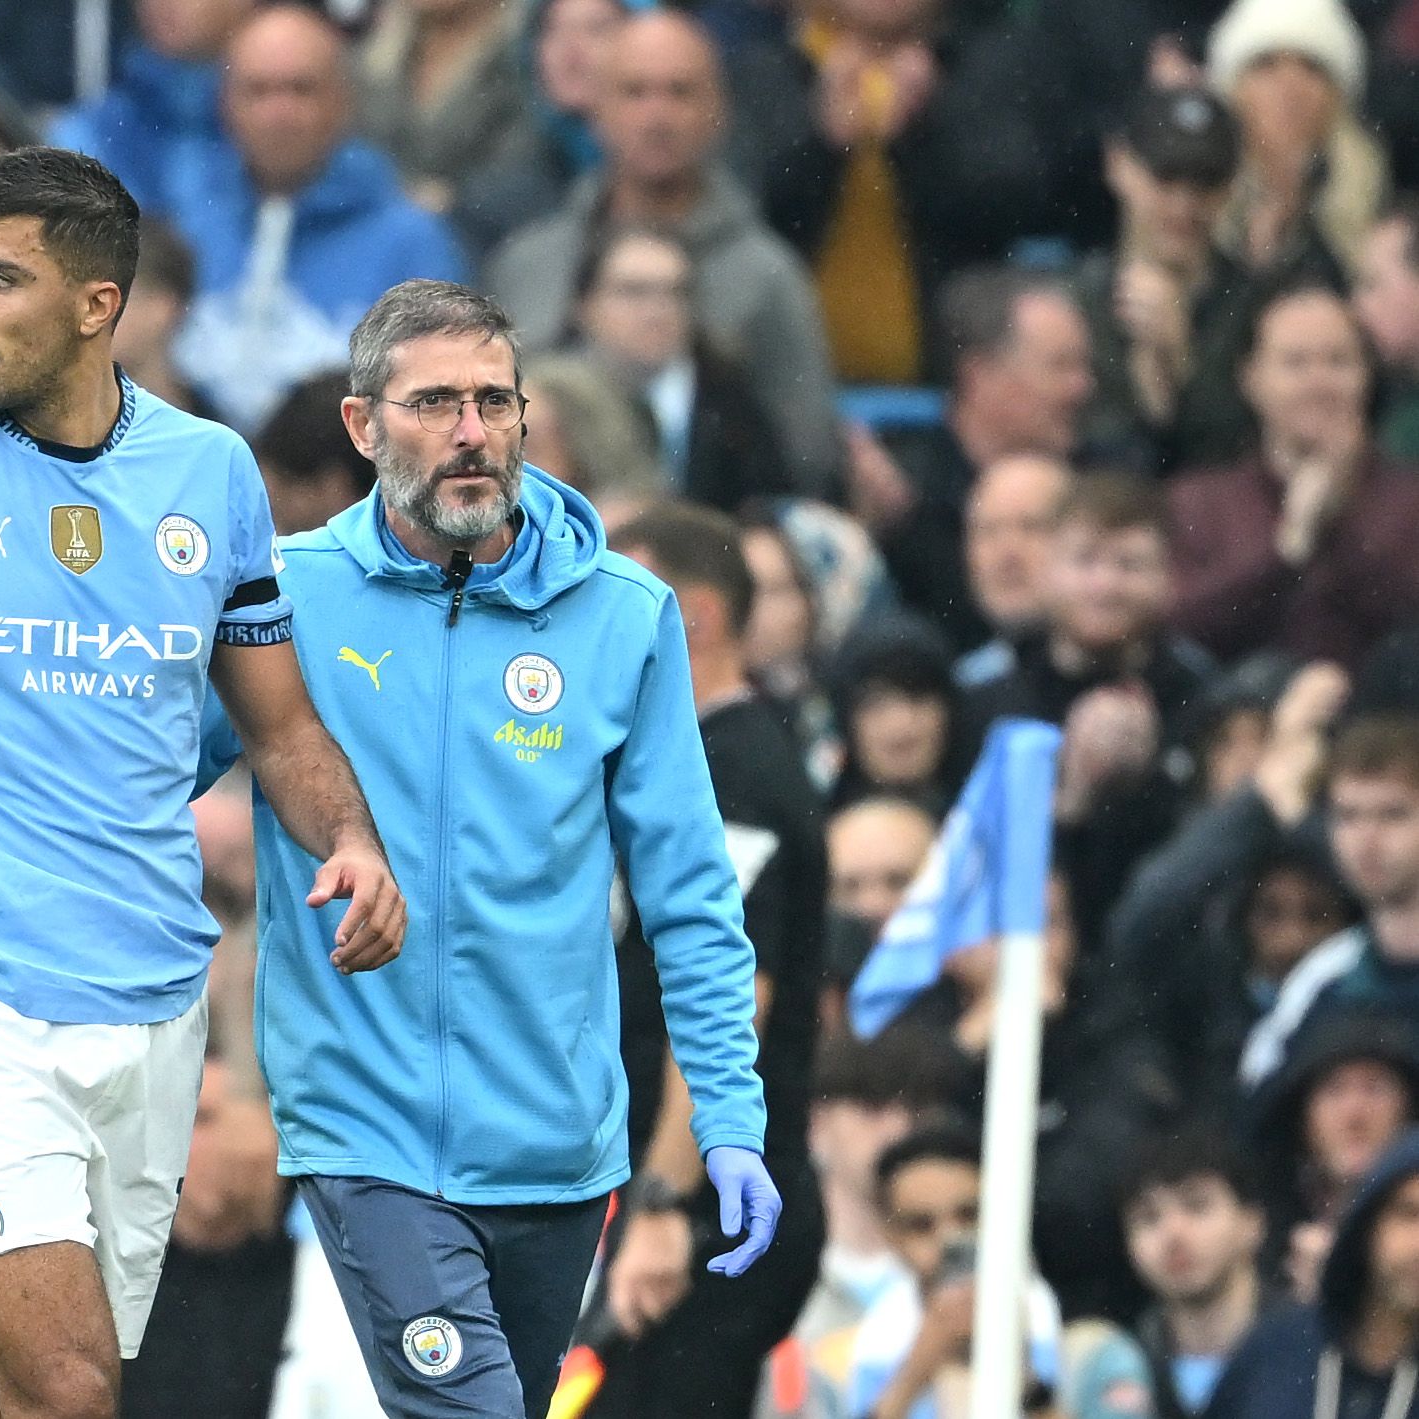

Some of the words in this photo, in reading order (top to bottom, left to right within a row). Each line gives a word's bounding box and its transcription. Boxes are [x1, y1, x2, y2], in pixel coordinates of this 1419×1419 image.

[66, 548, 90, 558] FIFA
[21, 669, 156, 698] AIRWAYS
[494, 719, 563, 750] Asahi
[431, 1364, 449, 1375] CITY
